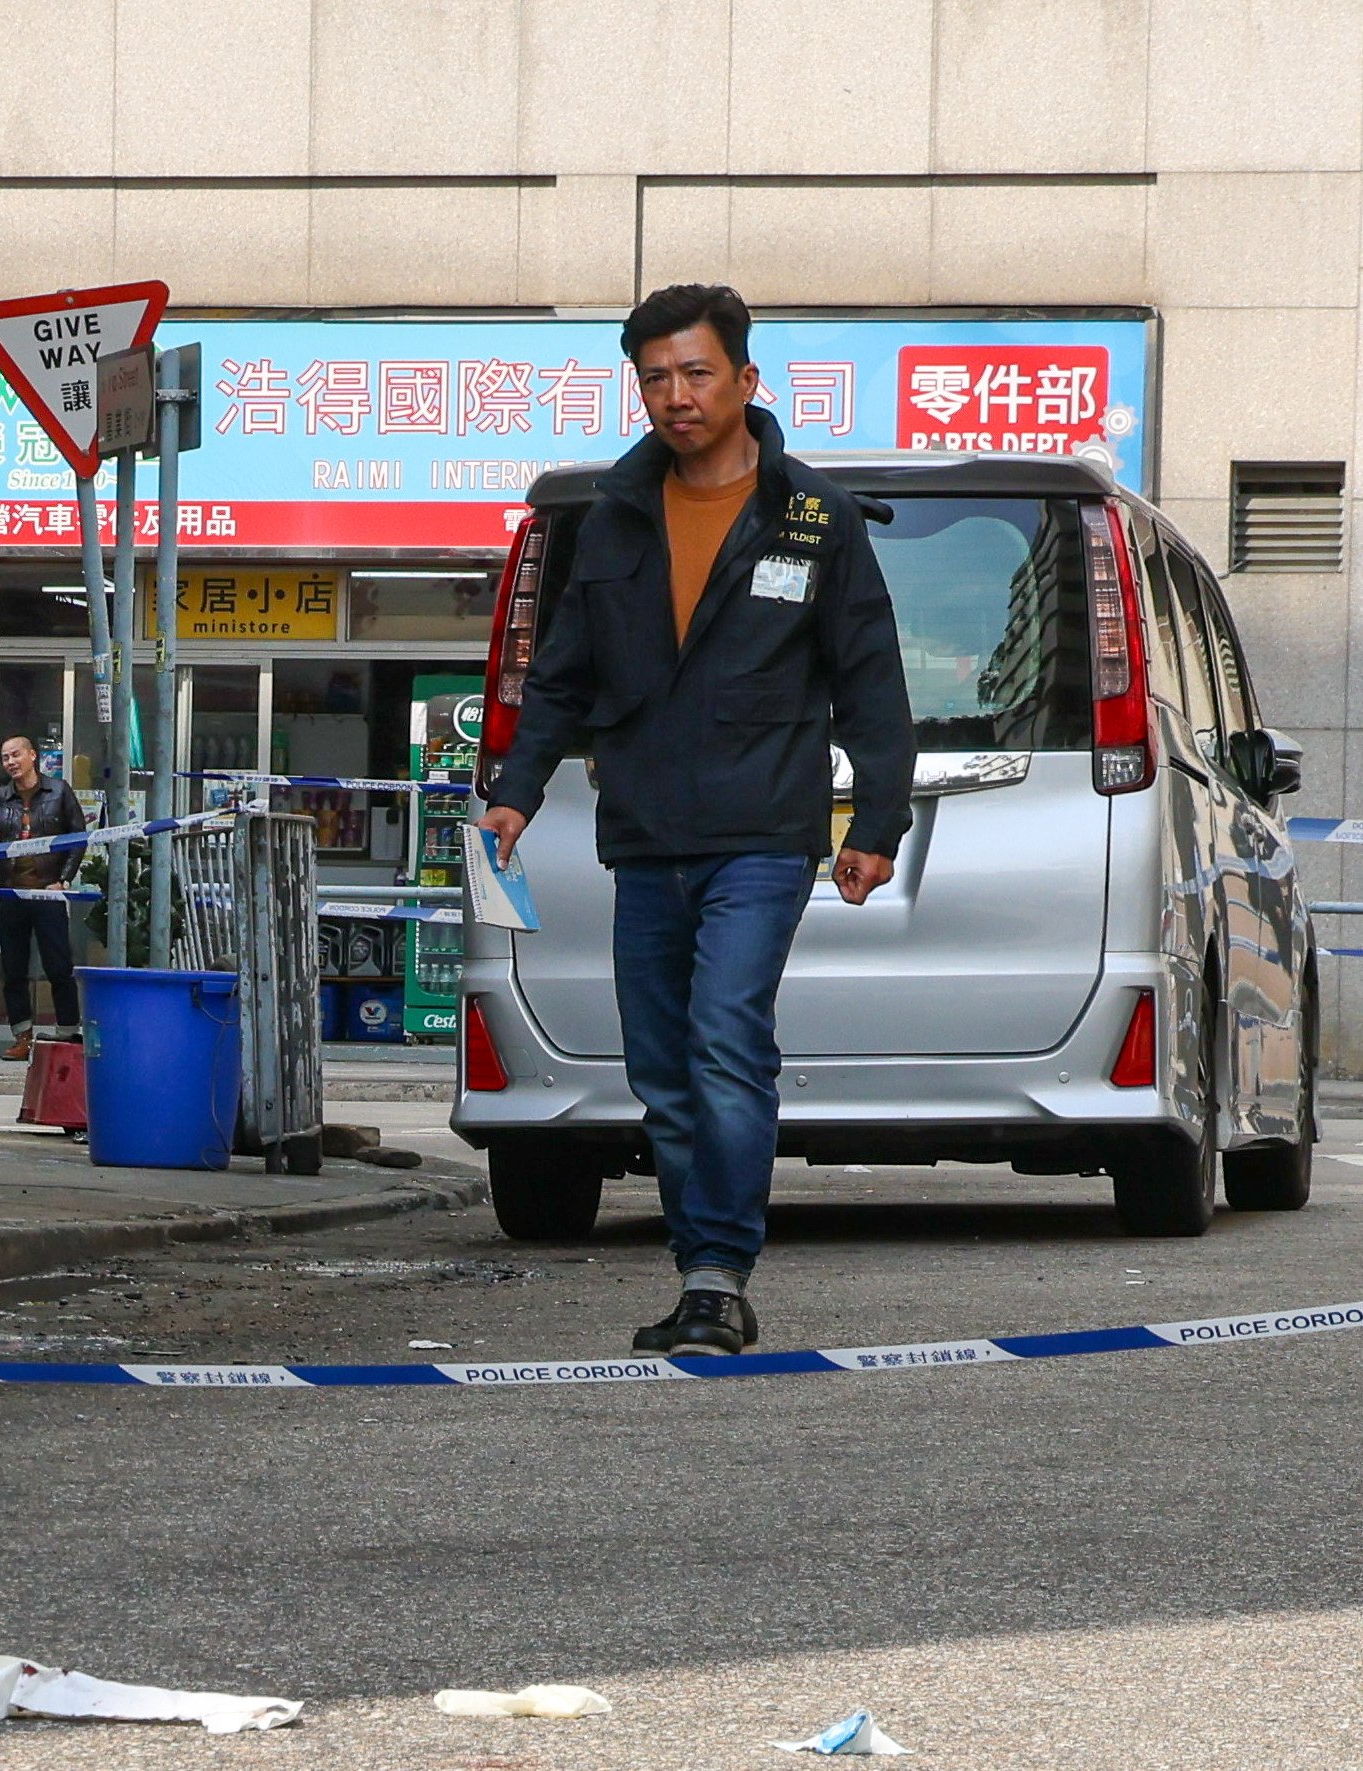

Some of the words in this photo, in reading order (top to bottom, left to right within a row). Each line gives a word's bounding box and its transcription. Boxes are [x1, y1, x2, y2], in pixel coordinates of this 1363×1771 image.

[33, 313, 101, 342] GIVE
[38, 341, 101, 370] WAY
[60, 380, 93, 412] 讓
[215, 357, 855, 437] 浩得國際有司
[909, 364, 1097, 425] 零件部
[10, 471, 59, 488] Since
[313, 460, 403, 490] RAIMI
[431, 460, 575, 490] INTERN
[787, 495, 821, 511] 察
[193, 619, 291, 634] ministore
[423, 1014, 457, 1028] C'est
[1179, 1320, 1270, 1341] POLICE
[465, 1367, 552, 1382] POLICE
